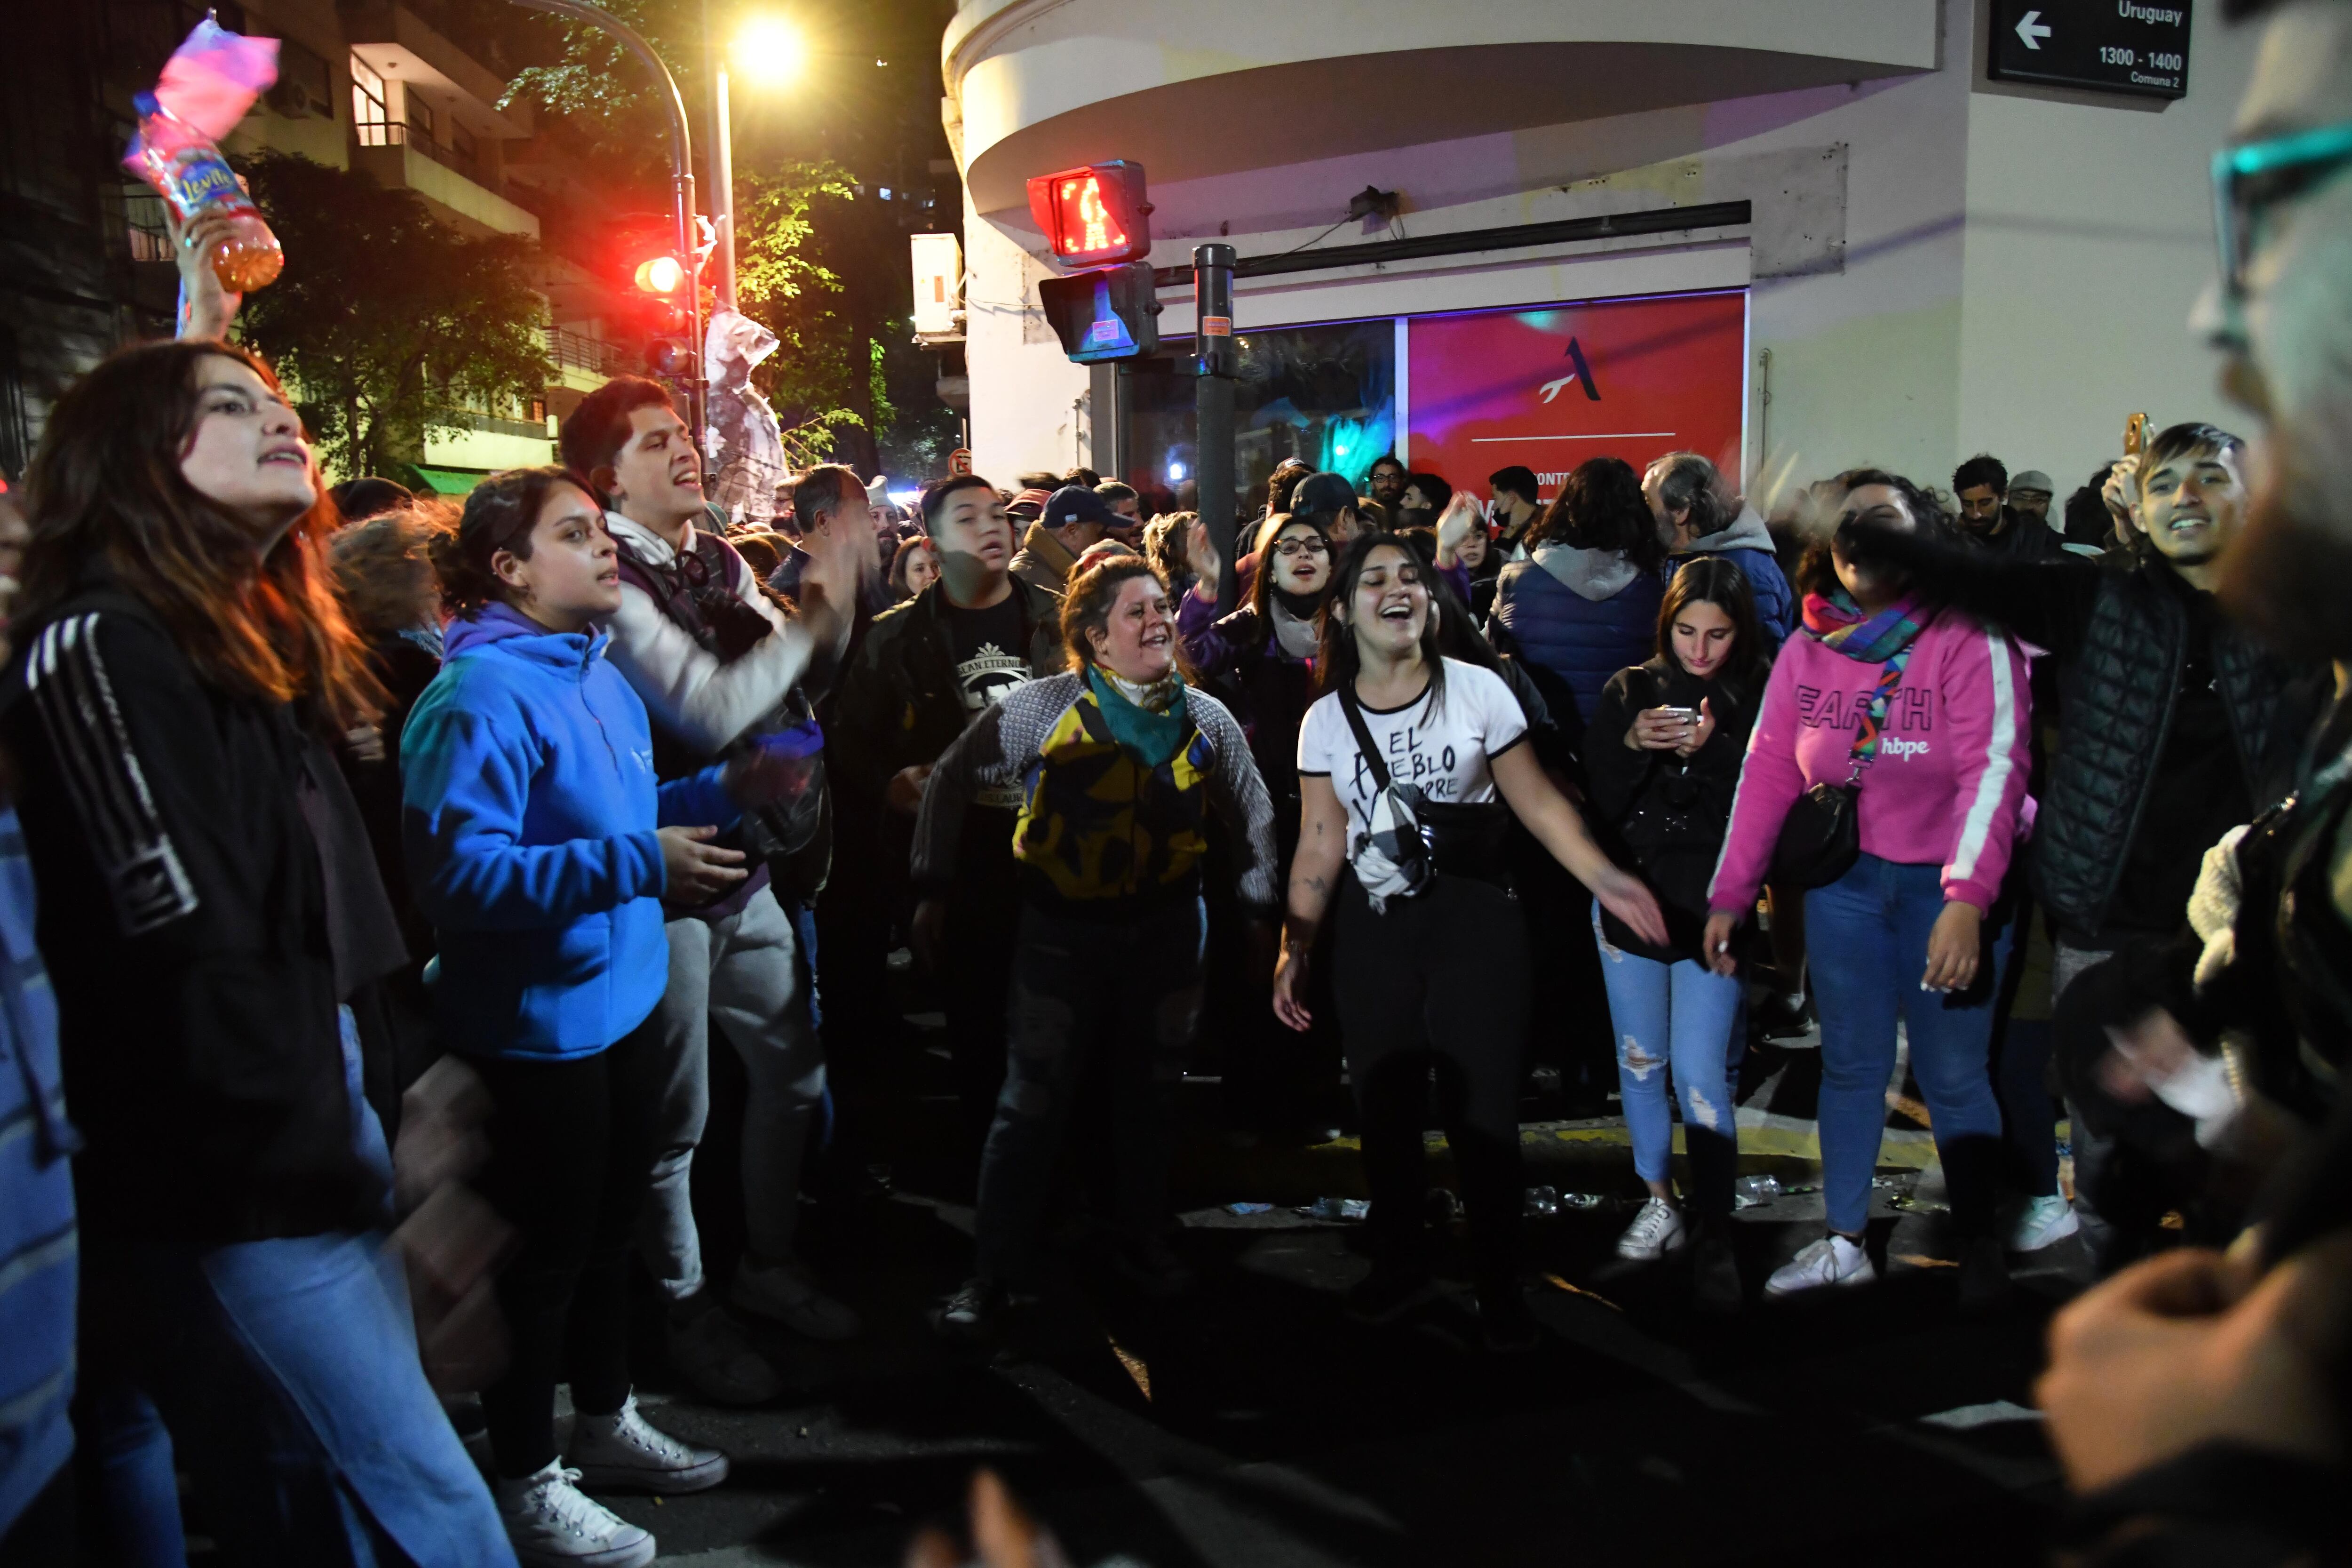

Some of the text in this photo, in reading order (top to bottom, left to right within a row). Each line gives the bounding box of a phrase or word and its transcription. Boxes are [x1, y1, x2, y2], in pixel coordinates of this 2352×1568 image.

[2118, 0, 2182, 27] Uruguay
[2100, 47, 2134, 66] 1300
[2148, 52, 2182, 71] 1400
[2131, 71, 2179, 88] Comuna 2
[1534, 472, 1570, 486] ONT
[1390, 727, 1422, 754] EL
[1349, 745, 1455, 799] PEBLO
[1422, 778, 1458, 799] PRE
